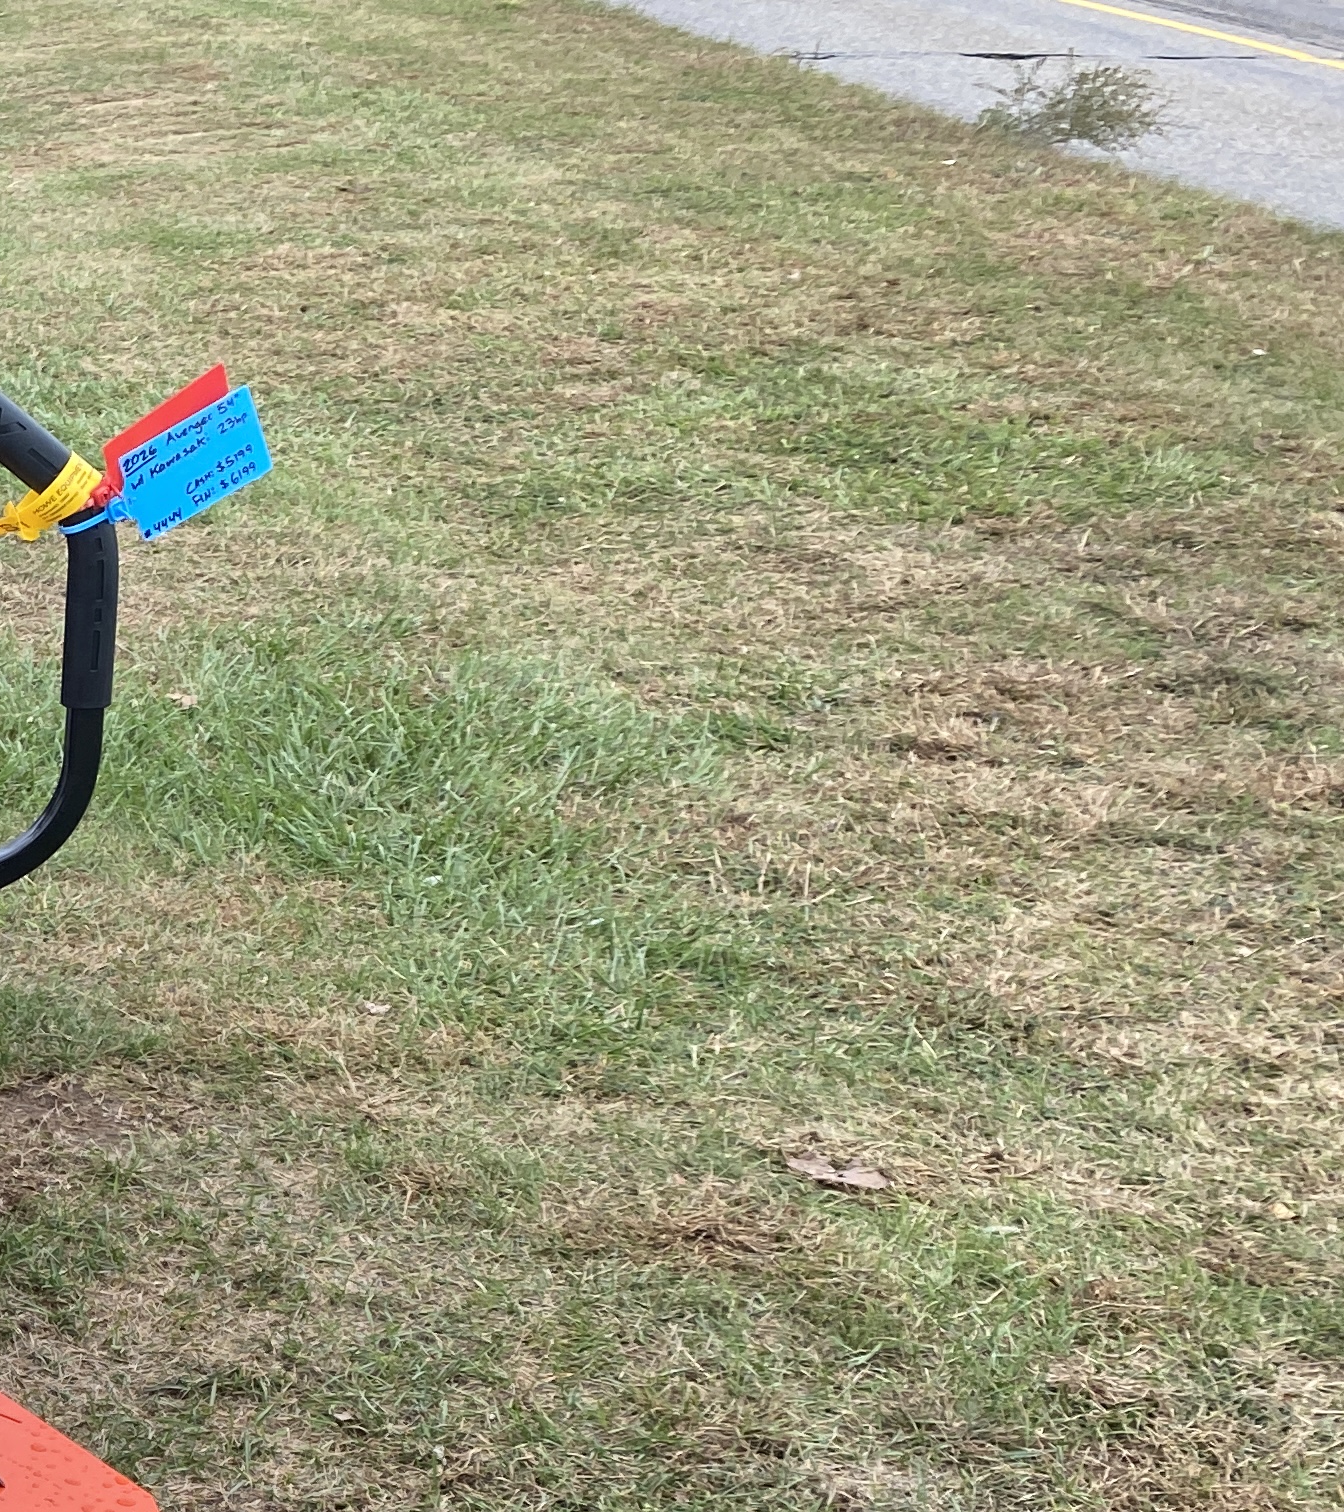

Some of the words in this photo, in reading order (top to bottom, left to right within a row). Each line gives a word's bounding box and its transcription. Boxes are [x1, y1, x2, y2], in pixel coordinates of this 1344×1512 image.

[122, 445, 158, 474] 2026
[166, 413, 213, 446] Avenger
[216, 444, 253, 473] $5199
[33, 495, 58, 514] HOWE
